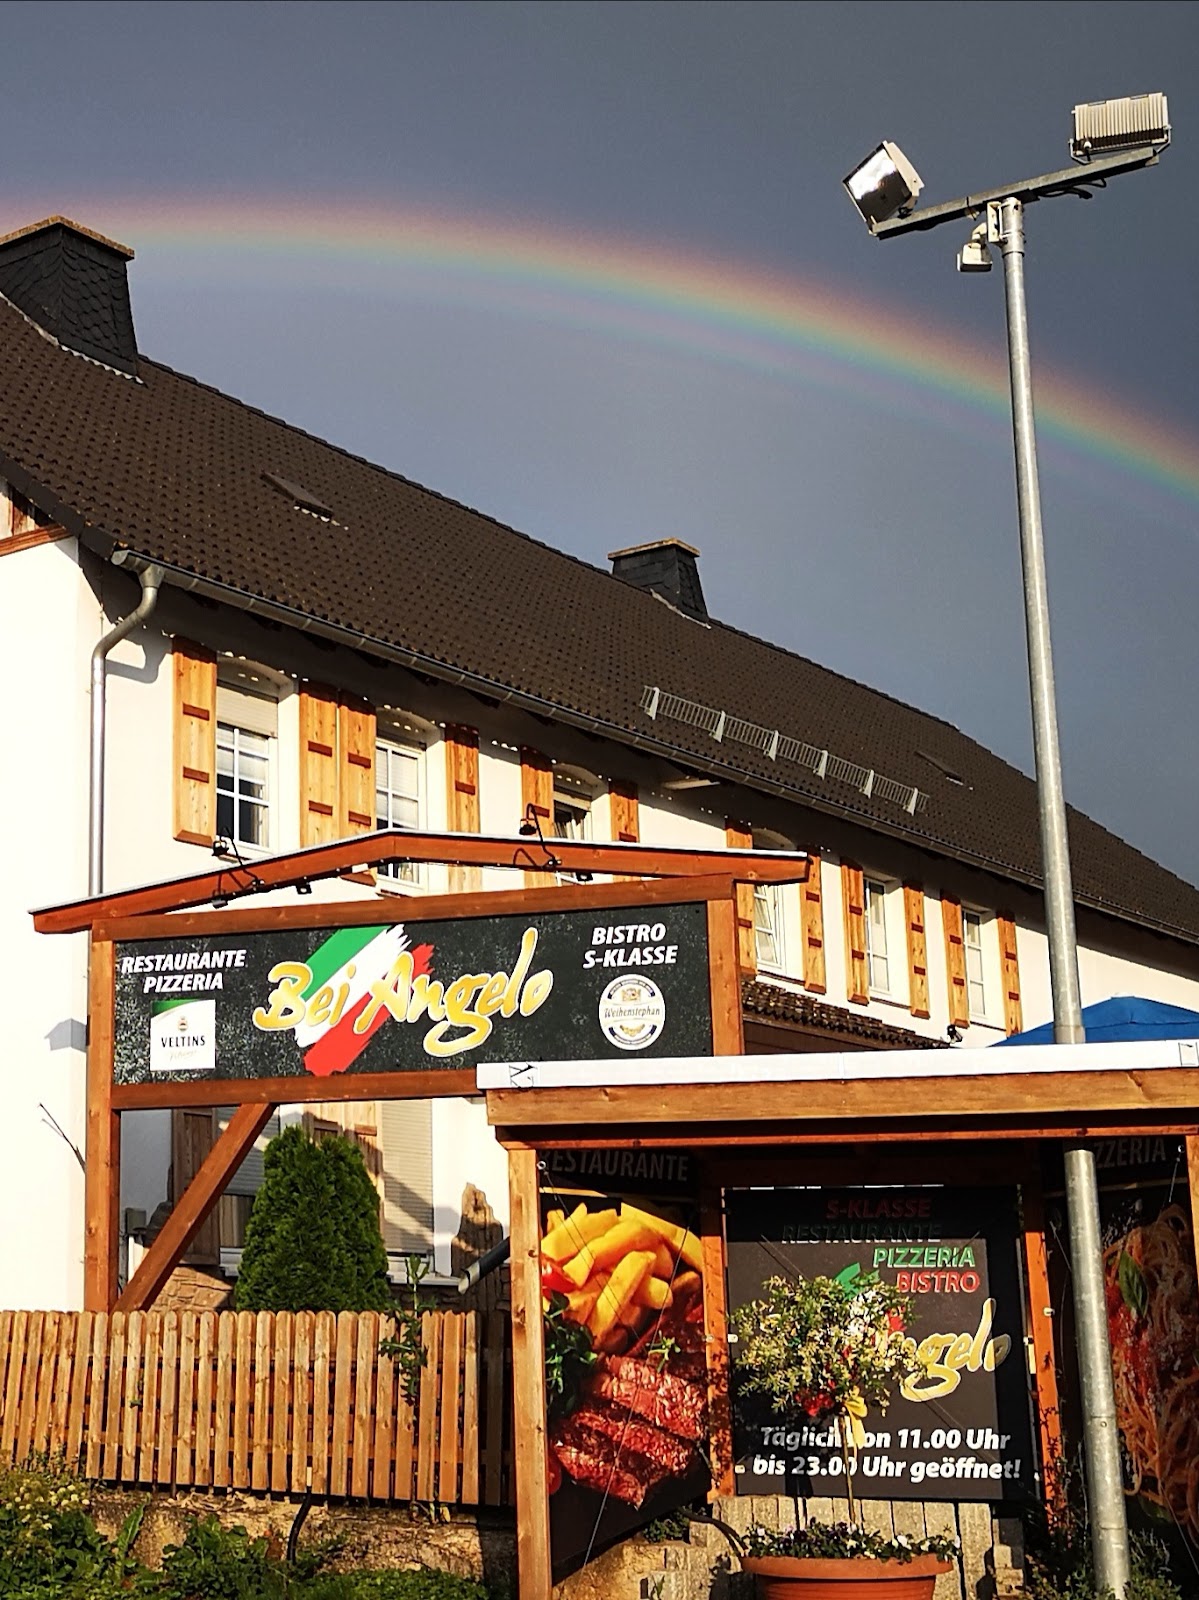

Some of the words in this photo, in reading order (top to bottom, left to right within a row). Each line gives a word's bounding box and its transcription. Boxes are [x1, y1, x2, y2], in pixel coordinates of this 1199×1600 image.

[591, 923, 667, 946] BISTRO
[121, 949, 247, 974] RESTAURANTE
[582, 945, 679, 969] S-KLASSE
[143, 972, 223, 994] PIZZERIA
[252, 961, 357, 1031] Bei
[353, 927, 554, 1057] Angelo
[161, 1035, 206, 1048] VELTINS
[1094, 1137, 1167, 1168] ZZERIA
[825, 1198, 933, 1219] S-KLASSE
[780, 1222, 942, 1244] RESTAURANTE
[873, 1246, 976, 1268] PIZZERIA
[897, 1270, 980, 1293] BISTRO
[874, 1298, 1012, 1402] ngelo
[848, 1430, 891, 1448] on
[898, 1428, 961, 1449] 11.00
[965, 1428, 1011, 1449] Uhr
[753, 1454, 786, 1476] bis
[792, 1455, 858, 1477] 23.00
[862, 1455, 907, 1477] Uhr
[909, 1457, 1021, 1483] geöffnet!
